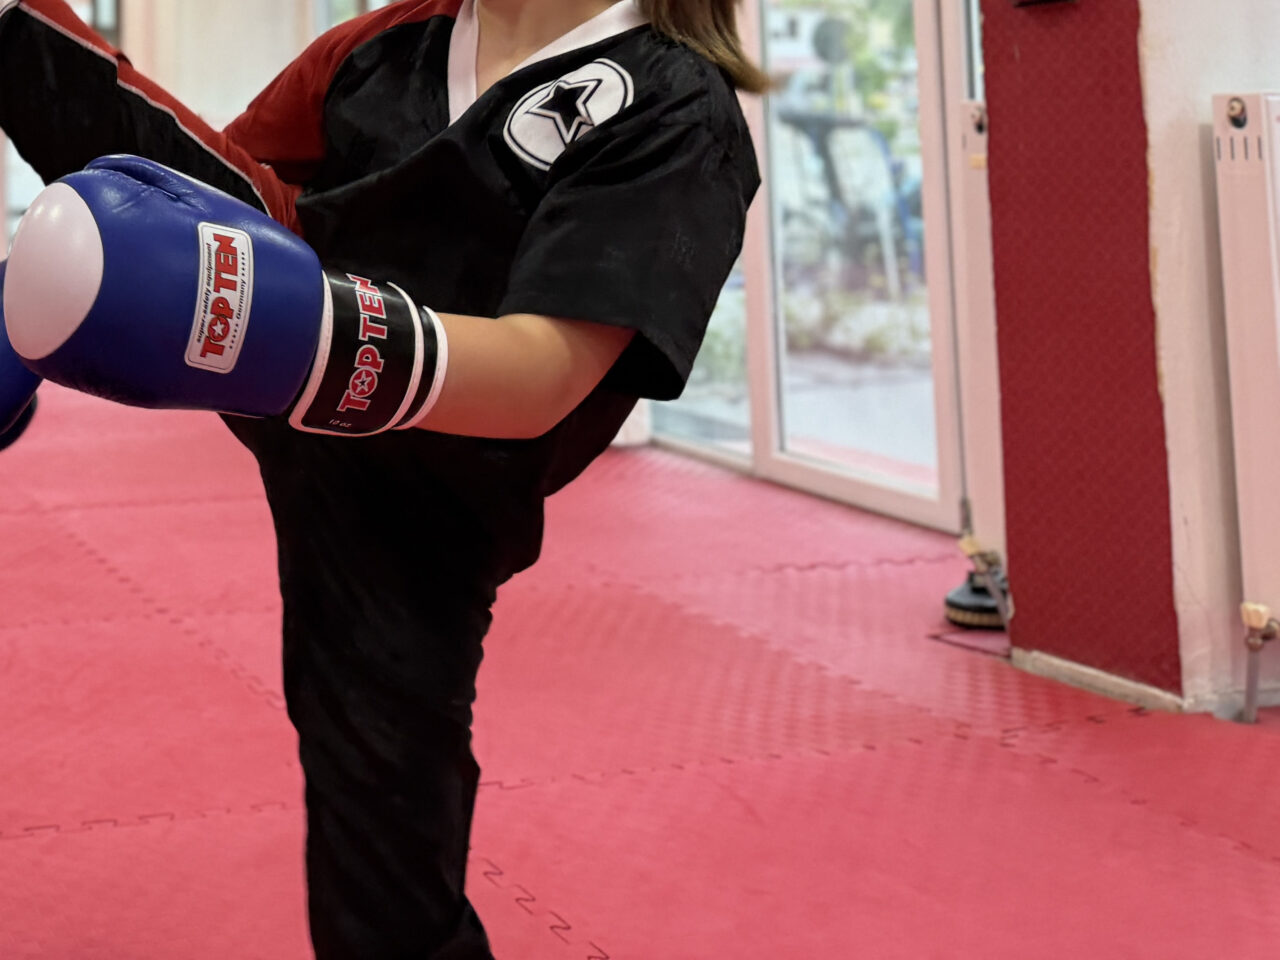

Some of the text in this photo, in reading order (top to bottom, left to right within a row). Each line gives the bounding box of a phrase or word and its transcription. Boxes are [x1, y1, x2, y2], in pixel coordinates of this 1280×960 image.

[200, 233, 238, 358] TOP TEN
[236, 278, 247, 320] Germany
[336, 273, 387, 412] TOP TEN
